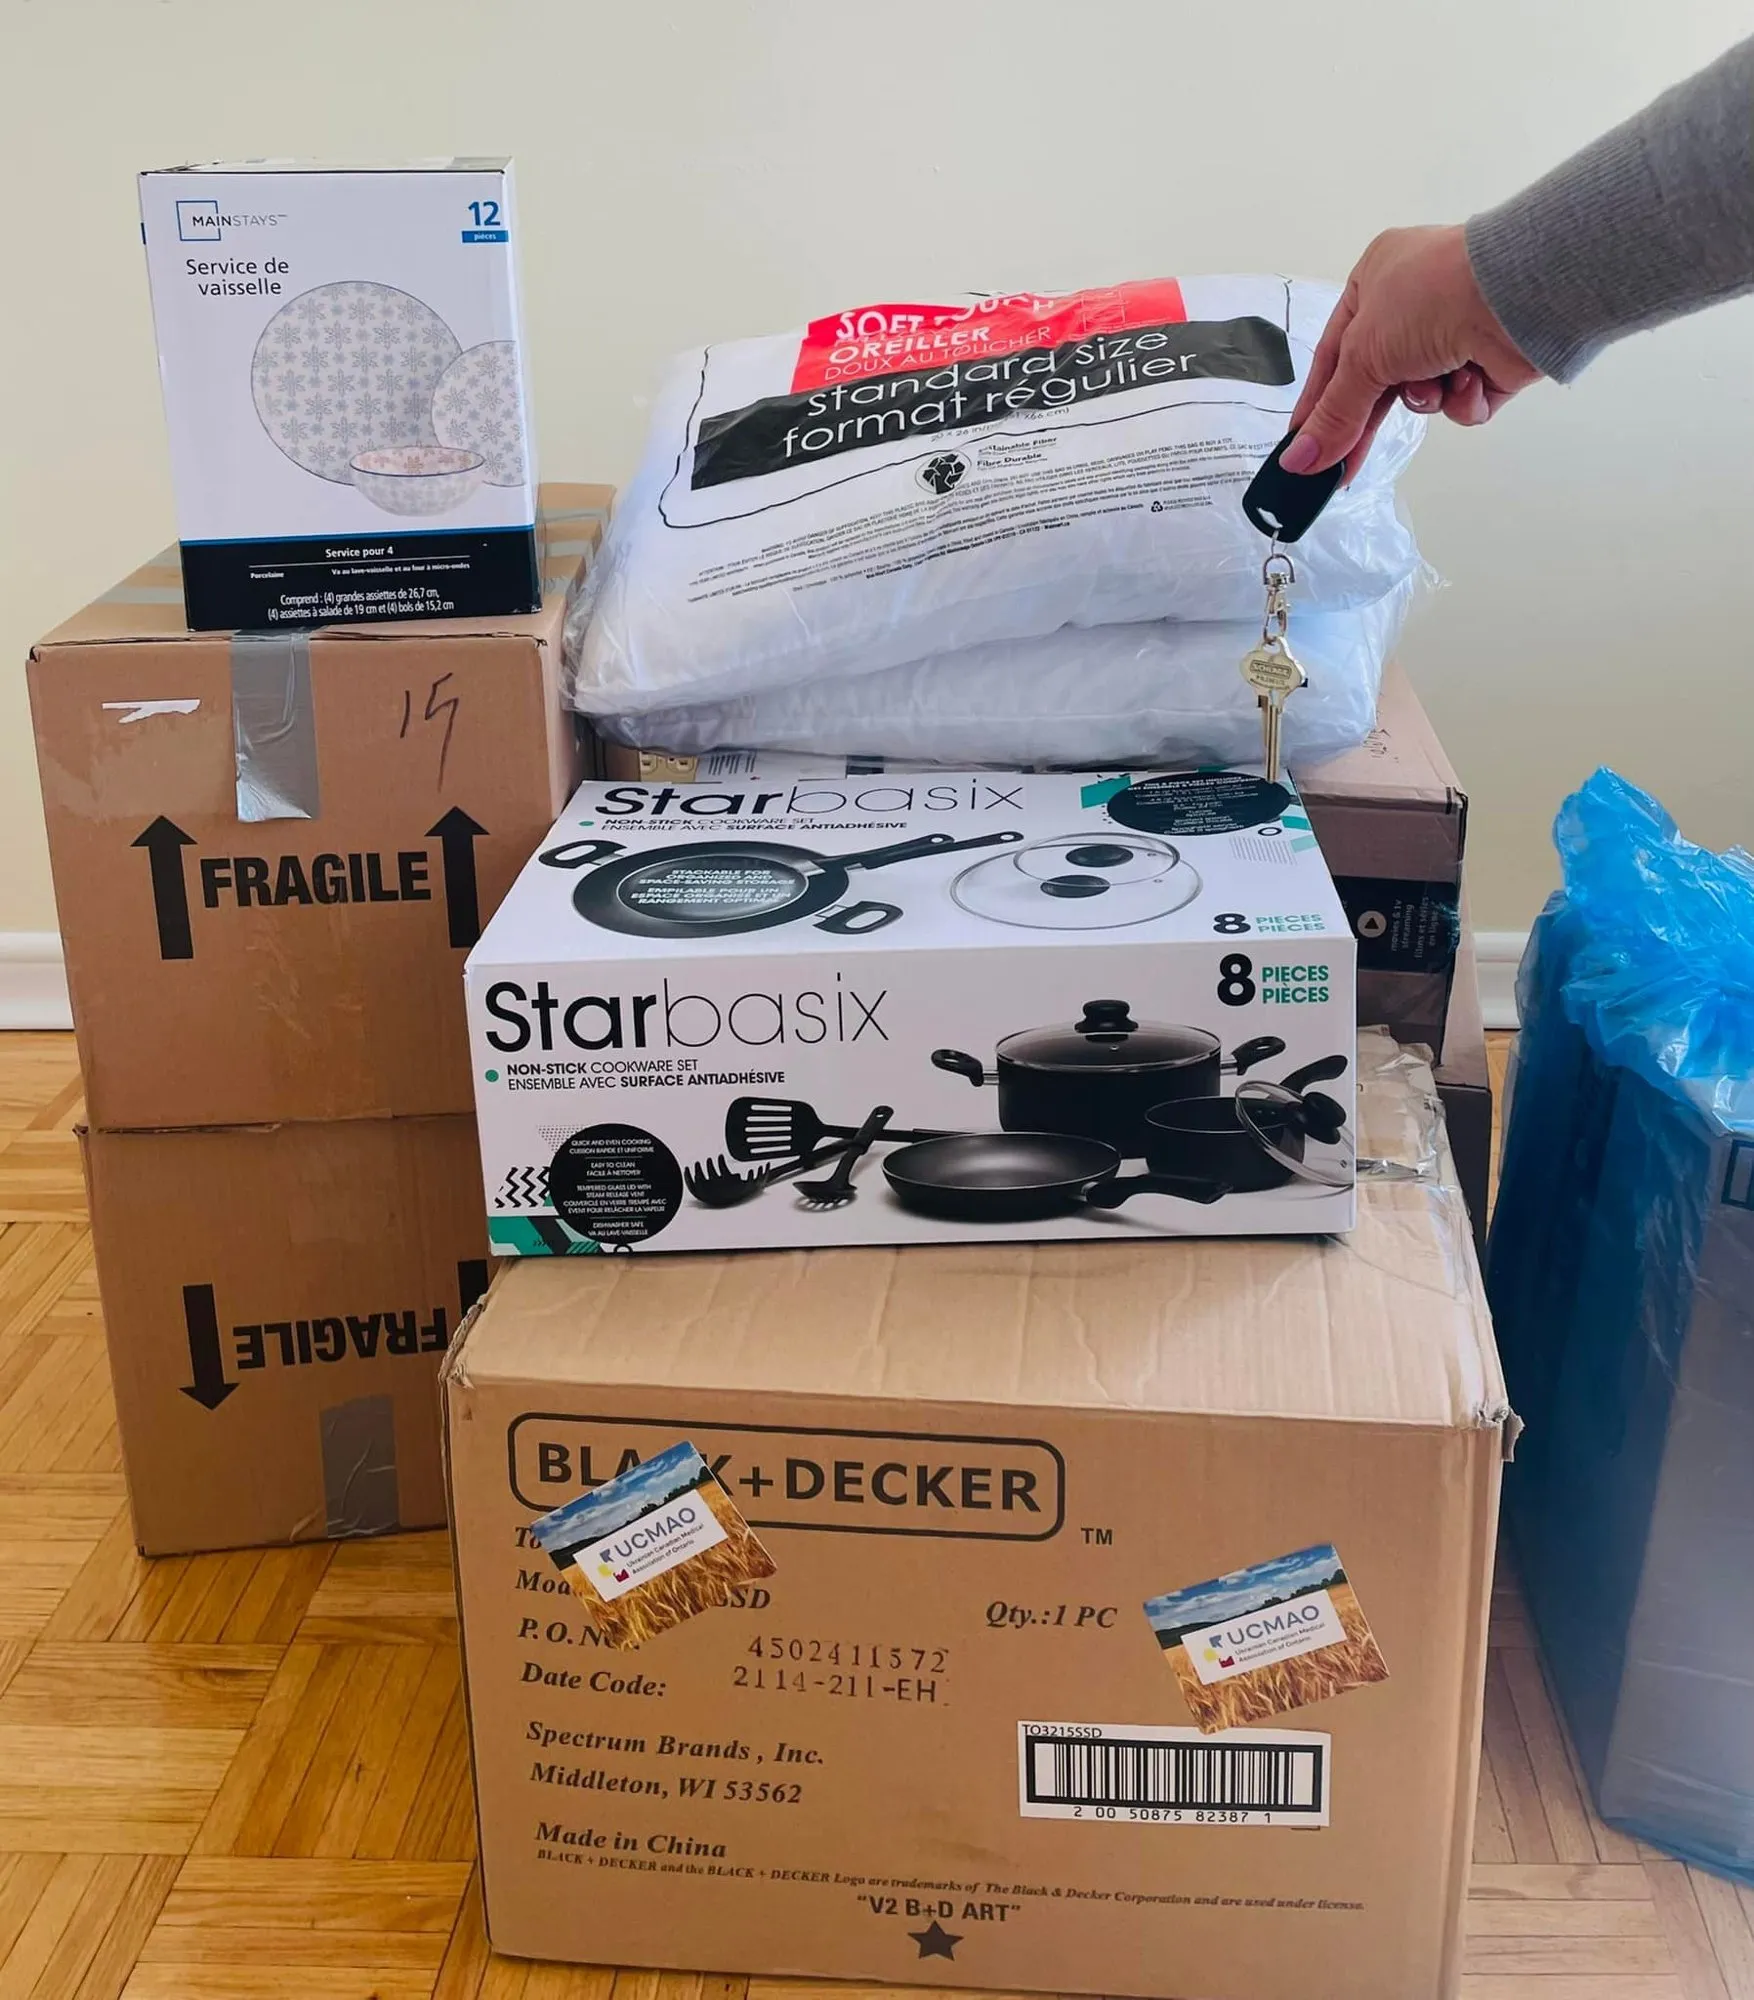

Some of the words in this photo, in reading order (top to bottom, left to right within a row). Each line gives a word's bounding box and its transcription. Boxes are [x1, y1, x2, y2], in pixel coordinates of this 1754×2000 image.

[192, 214, 279, 227] MAINSTAYS
[468, 201, 501, 226] 12
[186, 258, 257, 275] Service
[264, 257, 289, 274] de
[198, 278, 282, 296] vaisselle
[825, 354, 892, 381] DOUX
[900, 352, 934, 366] AU
[943, 326, 1052, 358] TOUCHER
[829, 326, 991, 364] OREILLER
[807, 350, 1057, 417] standard
[1076, 332, 1169, 365] size
[783, 390, 968, 458] format
[986, 354, 1197, 412] régulier
[325, 548, 360, 558] Service
[362, 547, 385, 558] pour
[386, 546, 394, 555] 4
[280, 593, 319, 607] Comprend
[336, 591, 365, 605] grandes
[366, 589, 397, 601] assiettes
[398, 588, 408, 599] de
[408, 587, 425, 600] 26,7
[268, 608, 279, 621] (4)
[280, 606, 312, 619] assiettes
[312, 607, 318, 617] à
[319, 605, 343, 617] salade
[344, 604, 354, 616] de
[355, 604, 365, 615] 19
[366, 605, 377, 614] cm
[379, 603, 387, 613] et
[387, 602, 398, 614] (4)
[415, 601, 425, 612] de
[425, 600, 442, 612] 15,2
[443, 601, 455, 611] cm
[595, 778, 1023, 815] Starbasix
[700, 817, 788, 825] COOKWARE
[200, 851, 432, 908] FRAGILE
[1213, 913, 1251, 934] 8
[1256, 914, 1322, 924] PIECES
[1217, 953, 1256, 1007] 8
[1262, 965, 1329, 983] PIECES
[1262, 983, 1329, 1004] PIÈCES
[486, 972, 889, 1053] Starbasix
[507, 1063, 587, 1075] NON-STICK
[590, 1060, 674, 1074] COOKWARE
[677, 1059, 698, 1071] SET
[508, 1078, 575, 1090] ENSEMBLE
[579, 1077, 617, 1089] AVEC
[621, 1075, 684, 1087] SURFACE
[687, 1069, 785, 1086] ANTIADHÉSIVE
[232, 1307, 449, 1371] FRAGILE
[614, 1507, 696, 1557] UCMAO
[1081, 1528, 1114, 1545] TM
[1073, 1605, 1118, 1629] PC
[1227, 1605, 1320, 1645] UCMAO
[748, 1635, 948, 1674] 4502411572
[521, 1662, 582, 1690] Date
[590, 1671, 667, 1697] Code:
[734, 1666, 938, 1704] 2114-211-EH
[526, 1721, 647, 1753] Spectrum
[773, 1742, 824, 1765] Inc.
[1021, 1724, 1103, 1738] TO3215SSD
[530, 1762, 669, 1800] Middleton,
[678, 1777, 717, 1800] WI
[724, 1780, 803, 1804] 53562
[1073, 1806, 1083, 1817] 2
[1095, 1806, 1117, 1819] 00
[1129, 1808, 1182, 1821] 50875
[1195, 1811, 1249, 1824] 82387
[1264, 1812, 1271, 1823] 1
[535, 1822, 607, 1849] Made
[613, 1831, 638, 1851] in
[647, 1834, 728, 1859] China
[537, 1849, 583, 1866] BLACK
[598, 1857, 657, 1872] DECKER
[661, 1862, 683, 1873] and
[686, 1862, 704, 1875] the
[707, 1865, 755, 1879] BLACK
[771, 1869, 830, 1883] DECKER
[834, 1872, 865, 1886] Logo
[868, 1878, 889, 1887] are
[891, 1878, 963, 1892] trademarks
[965, 1881, 980, 1894] of
[985, 1882, 1009, 1894] The
[1012, 1885, 1048, 1897] Black
[1051, 1887, 1063, 1897] &
[1066, 1887, 1112, 1901] Decker
[1114, 1891, 1191, 1905] Corporation
[1194, 1894, 1218, 1906] and
[1221, 1897, 1243, 1906] are
[1277, 1898, 1315, 1909] under
[906, 1899, 953, 1918] B+D
